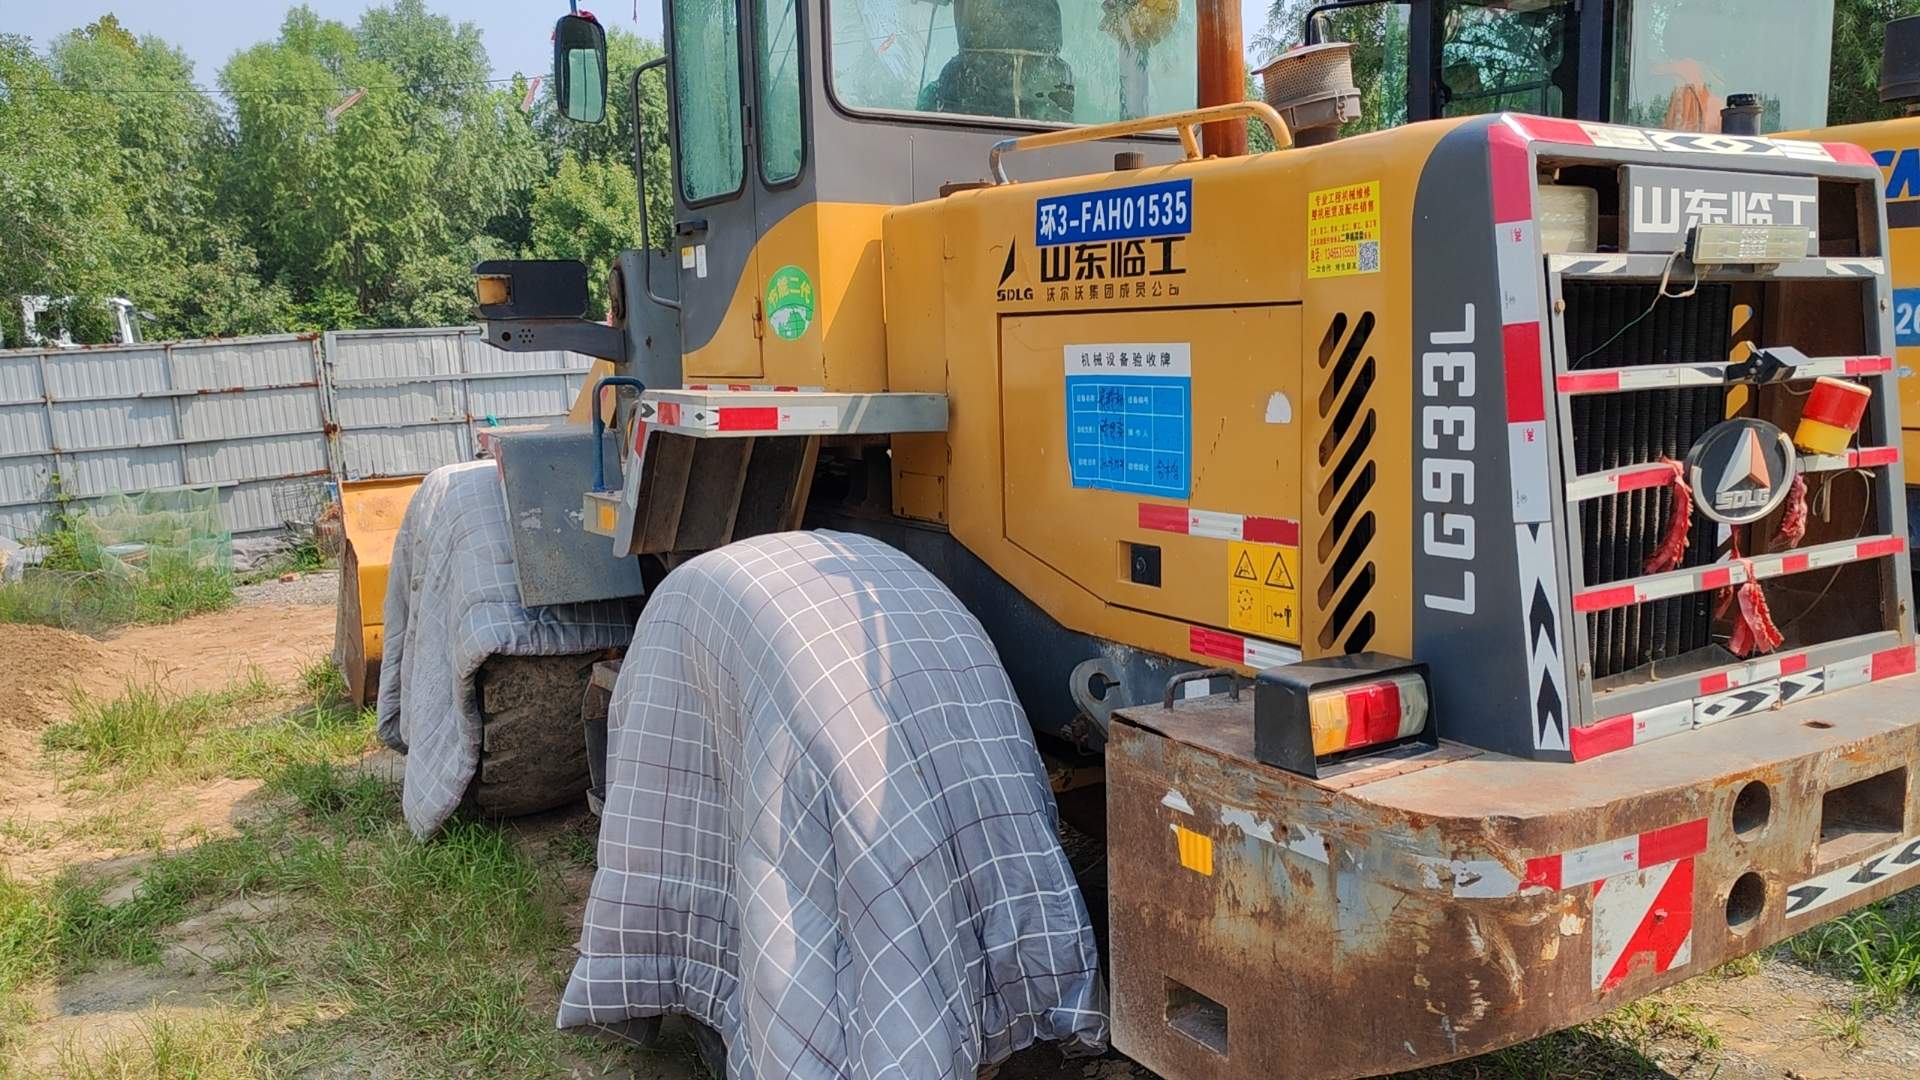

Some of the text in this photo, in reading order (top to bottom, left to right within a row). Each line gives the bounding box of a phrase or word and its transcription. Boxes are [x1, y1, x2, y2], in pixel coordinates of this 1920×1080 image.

[1040, 191, 1187, 240] 环3-FAH01535
[1040, 236, 1187, 283] 山东临工
[996, 287, 1034, 302] SDLG
[1081, 352, 1171, 368] 机械设备验收牌
[1422, 303, 1476, 615] LG933L
[1715, 488, 1770, 510] SDLG
